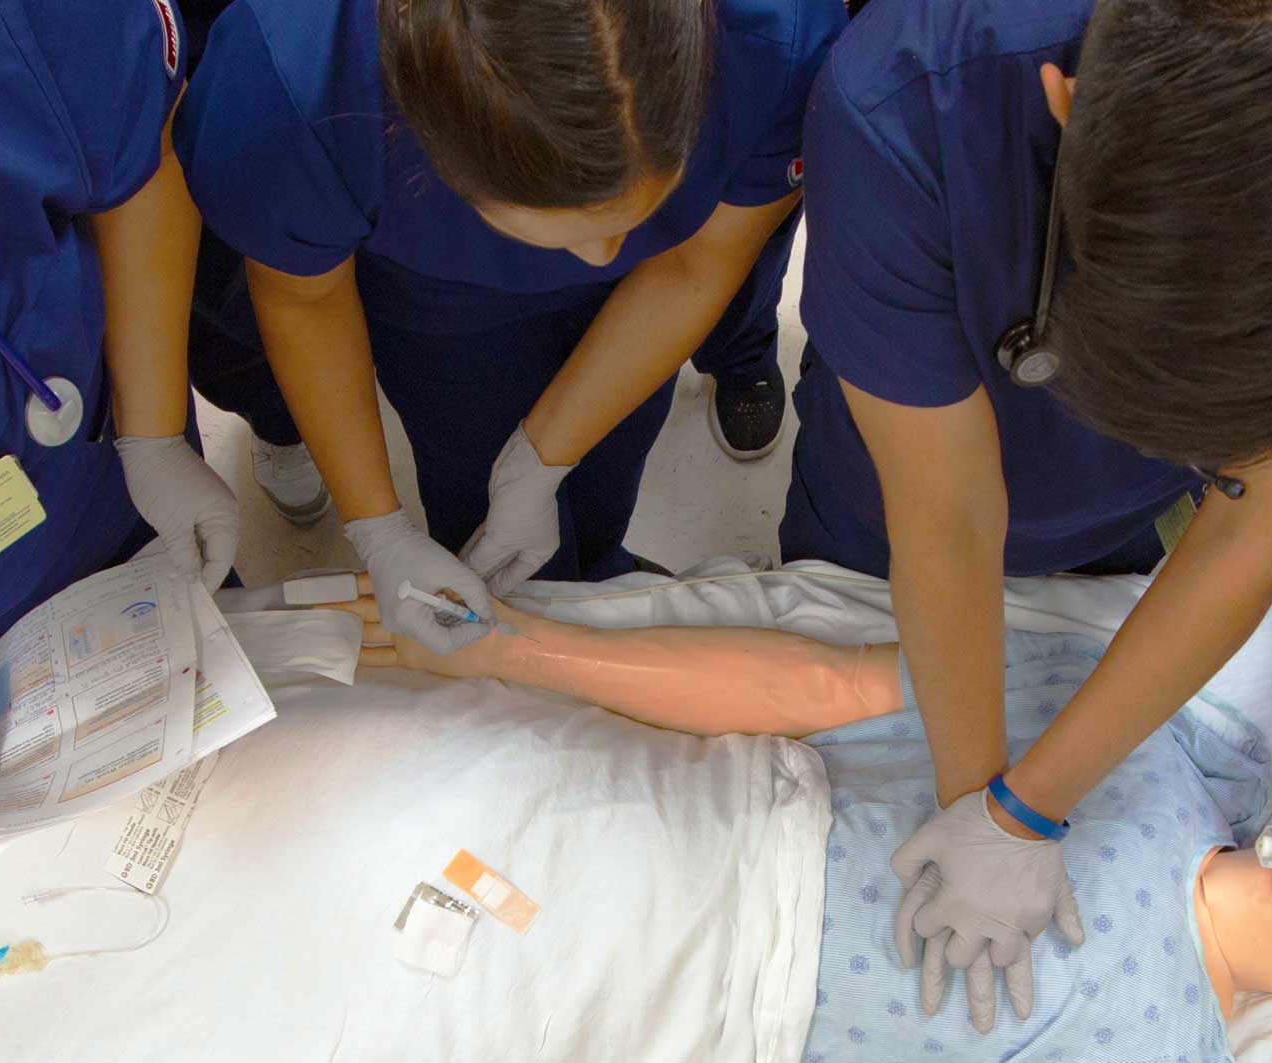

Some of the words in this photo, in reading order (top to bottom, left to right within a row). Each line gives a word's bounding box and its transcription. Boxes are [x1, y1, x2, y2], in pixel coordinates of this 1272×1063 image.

[124, 862, 133, 872] BD
[135, 827, 151, 850] Syringe
[149, 872, 157, 883] BD
[160, 838, 176, 861] Syringe
